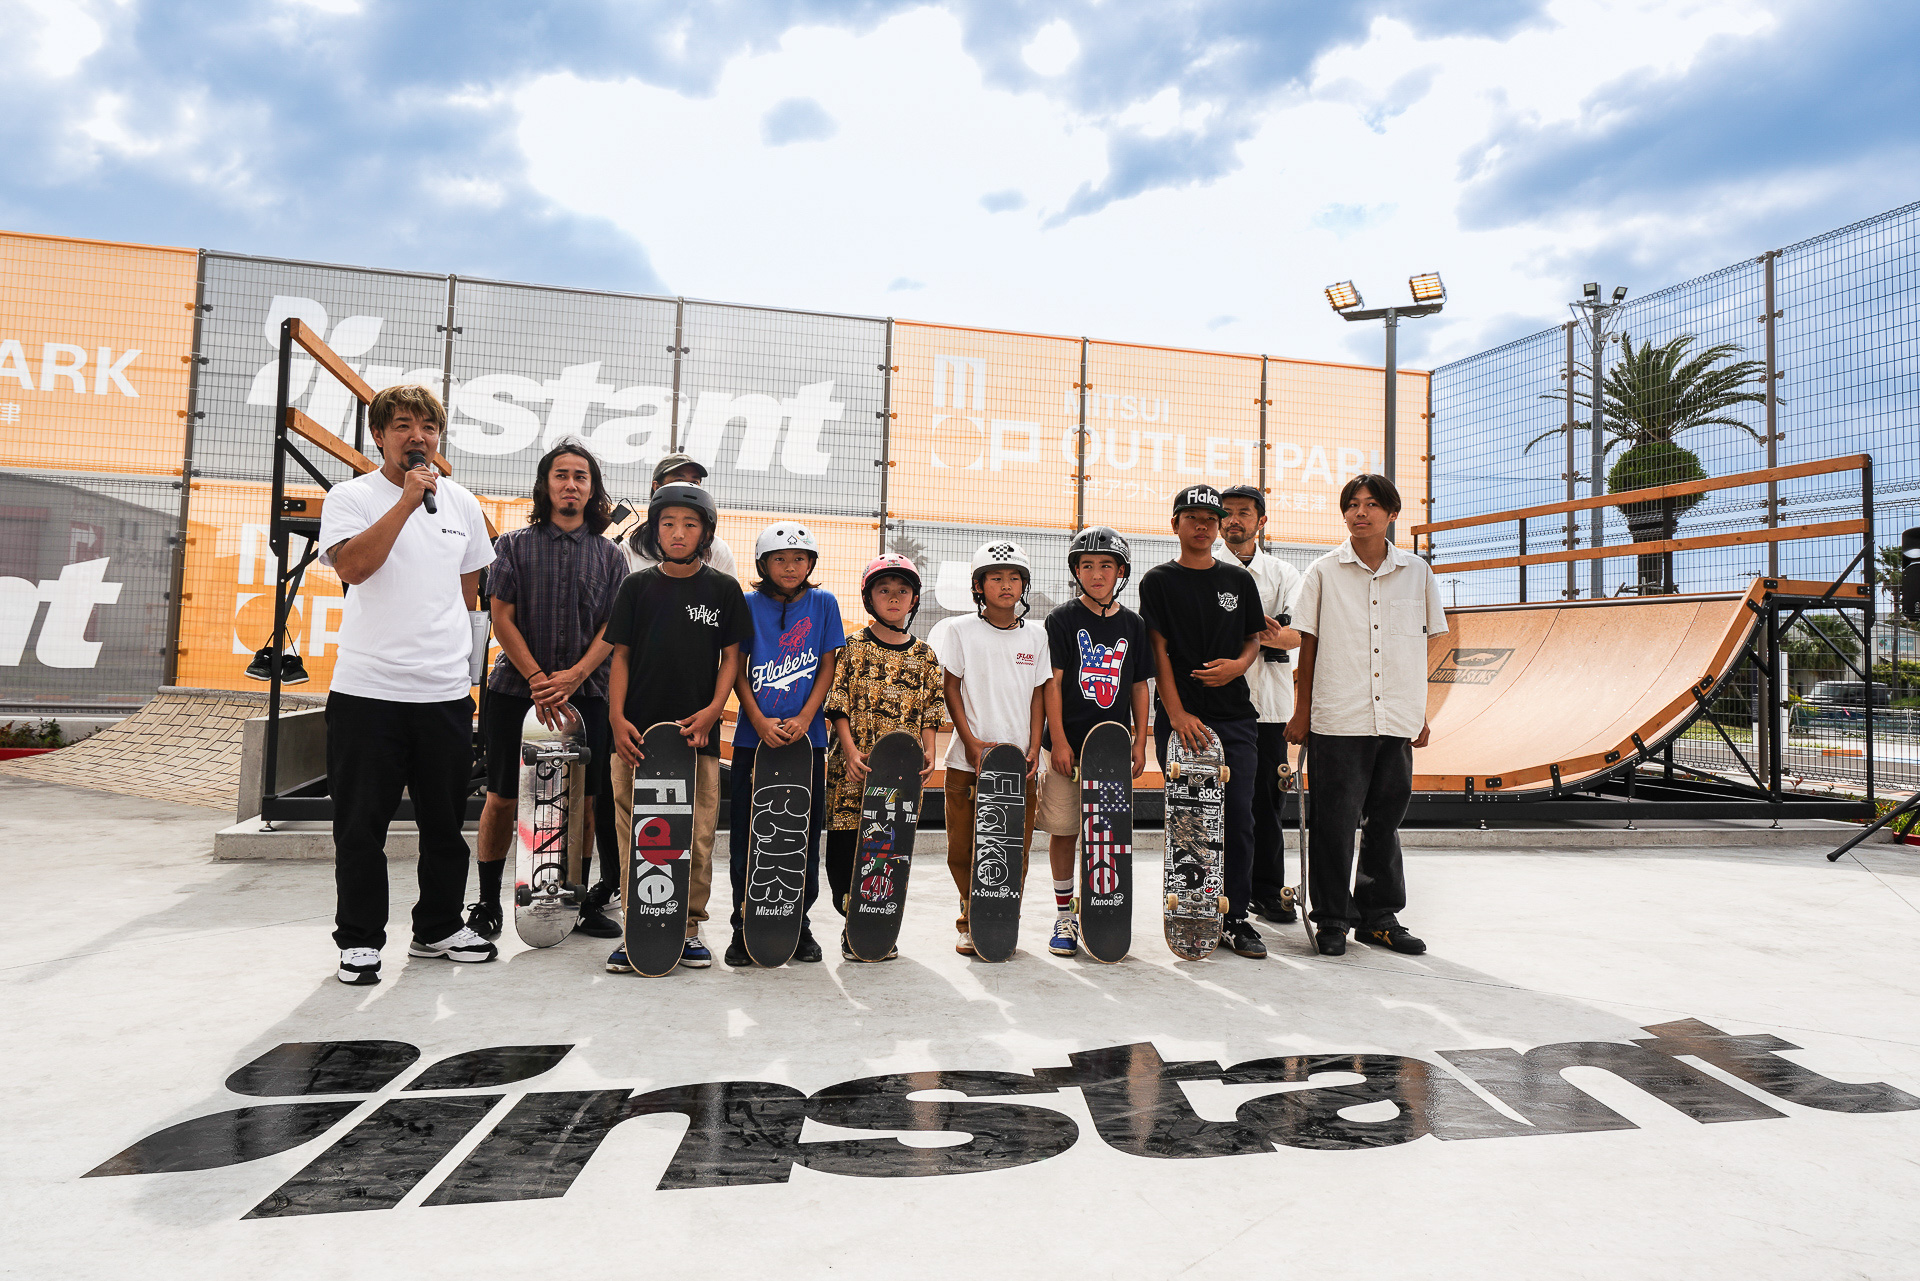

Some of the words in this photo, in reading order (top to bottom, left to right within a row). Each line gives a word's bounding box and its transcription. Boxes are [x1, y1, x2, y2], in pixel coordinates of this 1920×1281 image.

[247, 295, 844, 476] instant
[1064, 391, 1169, 423] MITSUI
[1062, 425, 1261, 479] OUTLET
[1275, 492, 1327, 510] 木更津
[752, 647, 818, 693] Flakers
[1430, 670, 1460, 681] GATOR
[1463, 670, 1496, 682] SKINS
[634, 779, 692, 904] Flake
[640, 904, 665, 916] Utage
[756, 904, 782, 916] Mizuki
[859, 904, 885, 914] Maara
[1091, 897, 1114, 906] Kanoa
[82, 1017, 1920, 1220] instant
